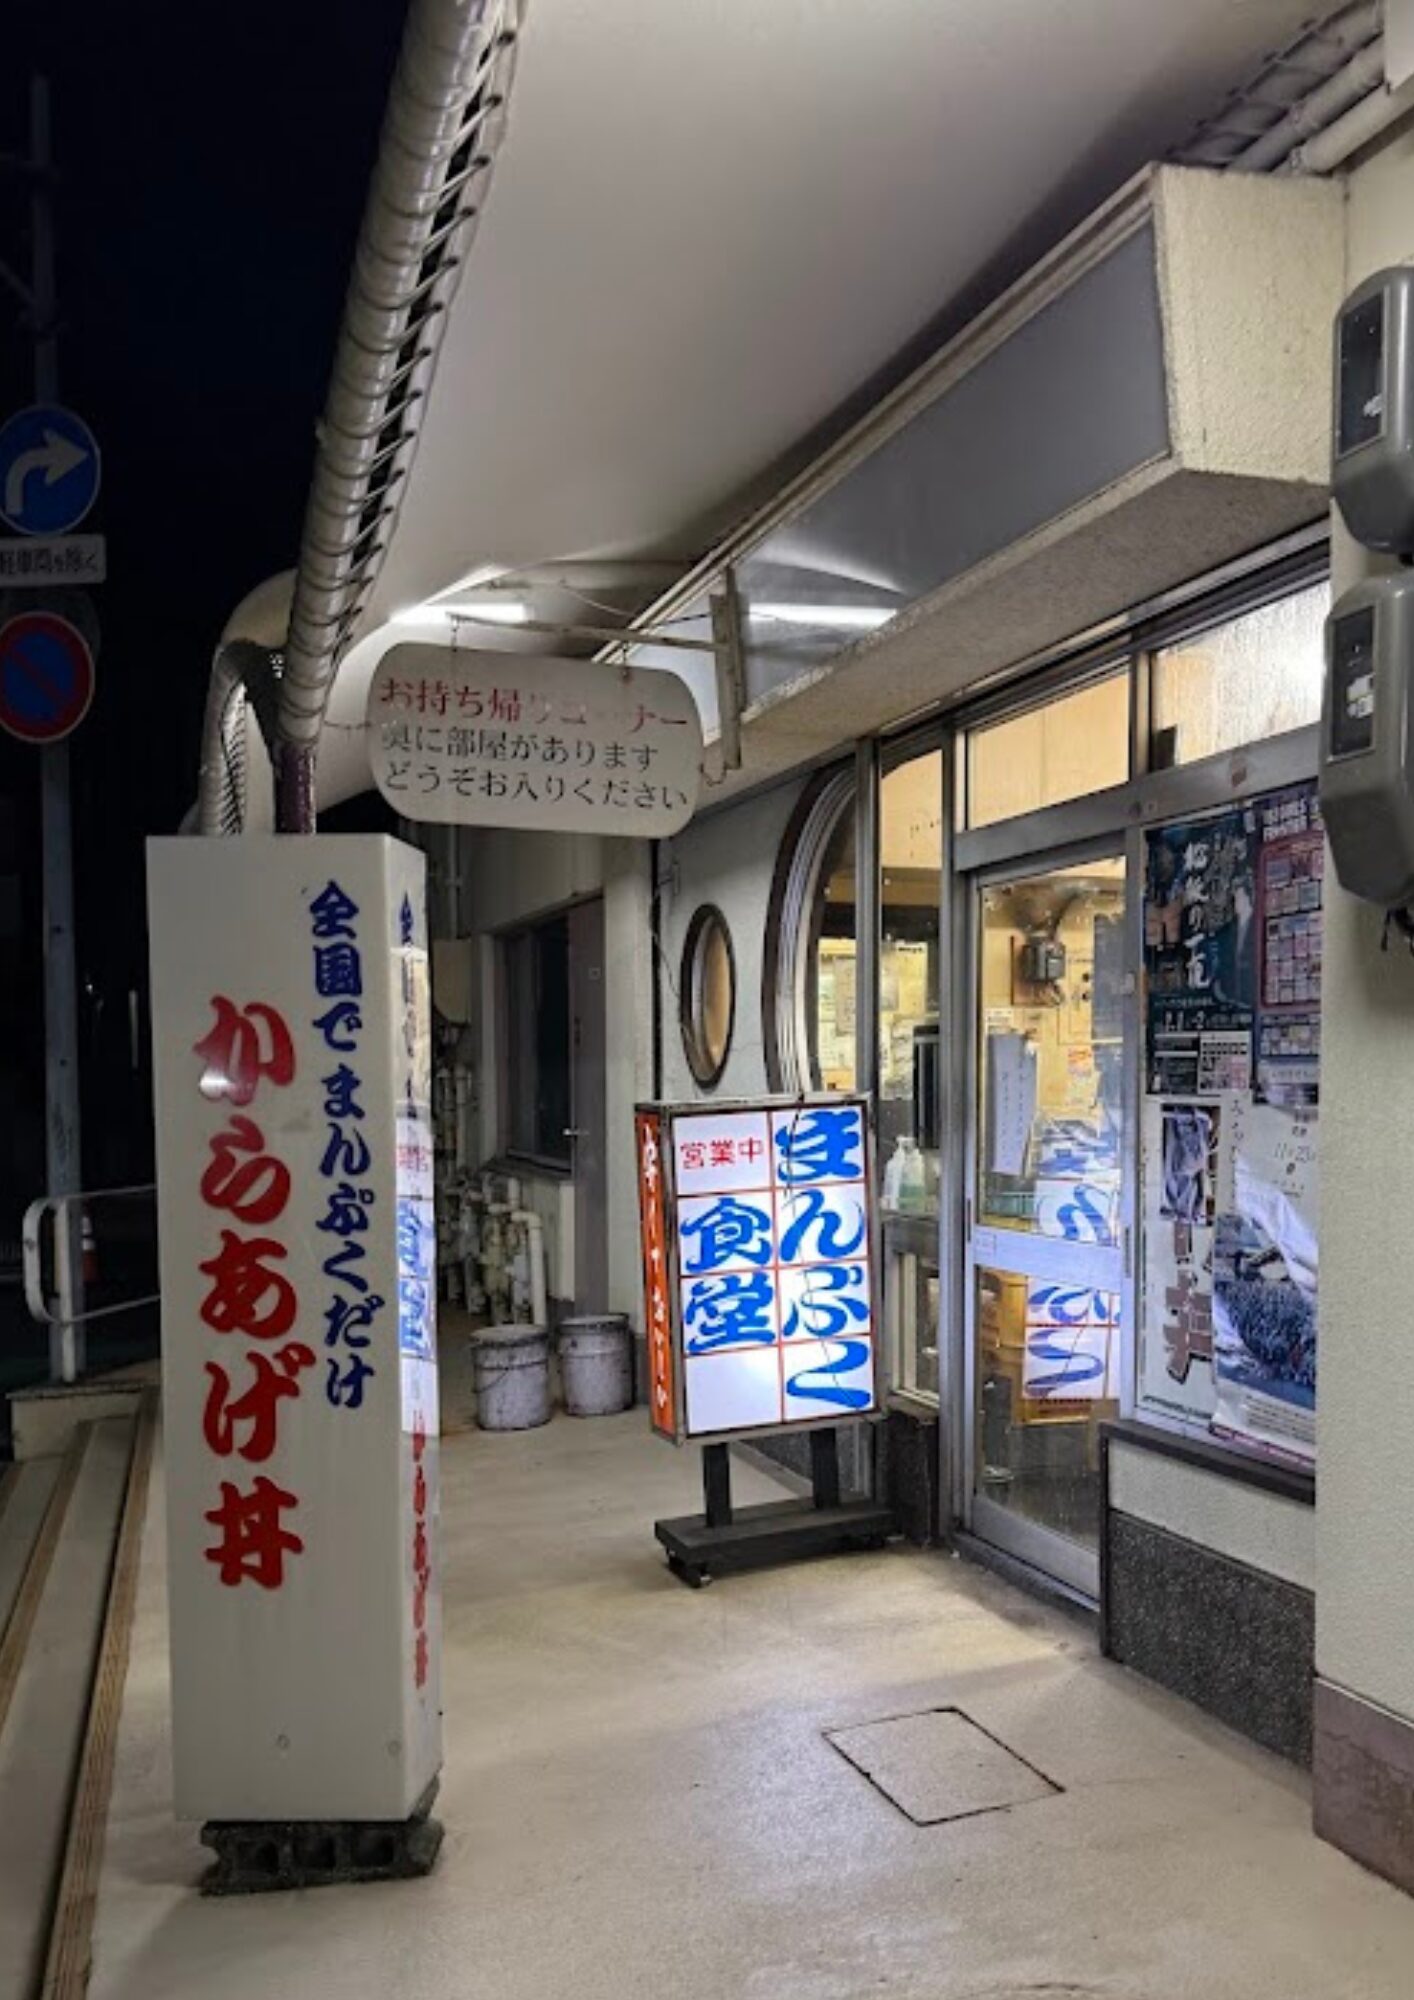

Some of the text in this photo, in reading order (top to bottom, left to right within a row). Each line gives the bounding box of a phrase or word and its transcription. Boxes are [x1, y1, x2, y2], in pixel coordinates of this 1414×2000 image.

[380, 726, 659, 772] 奥に部屋があります
[385, 760, 689, 810] どうぞお入りください
[308, 880, 385, 1408] 全国でまんぷくだけ
[680, 1136, 764, 1170] 営業中
[193, 993, 317, 1589] からあげ丼
[680, 1196, 776, 1355] 食堂
